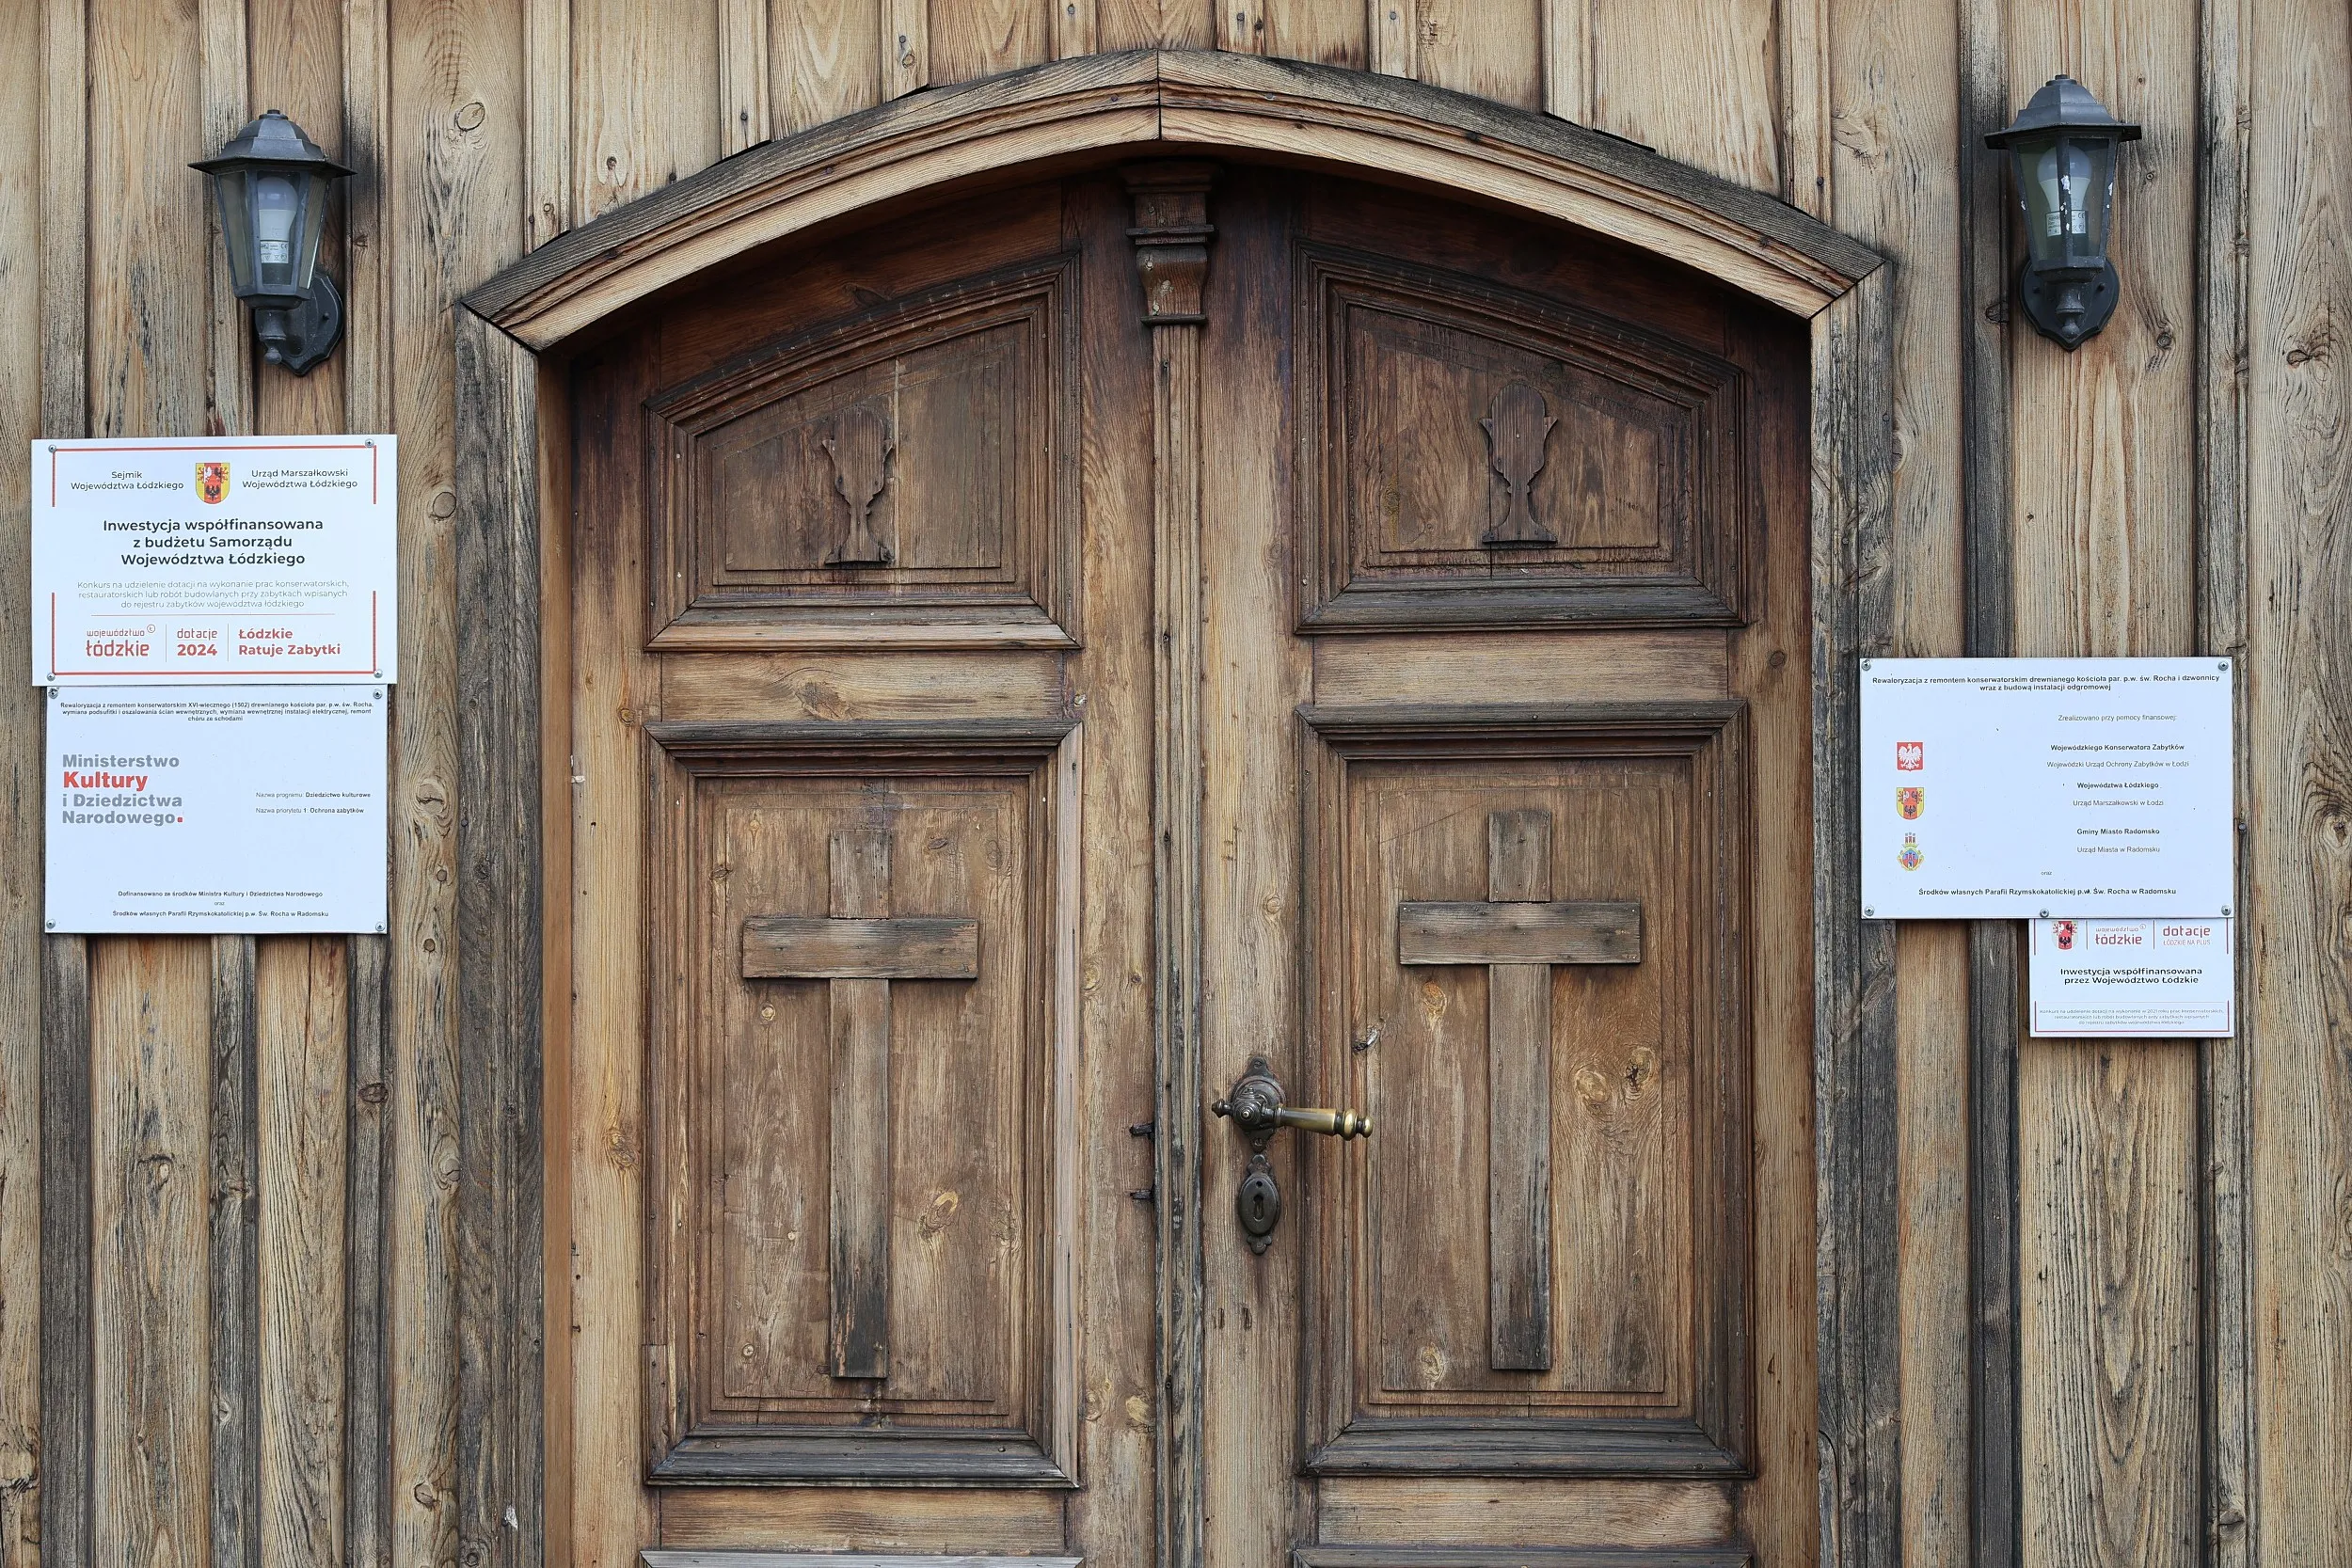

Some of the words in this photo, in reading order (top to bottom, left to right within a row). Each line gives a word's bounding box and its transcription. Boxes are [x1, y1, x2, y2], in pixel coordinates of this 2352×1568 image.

[112, 471, 142, 481] Sejmik
[251, 469, 278, 479] Urząd
[71, 482, 135, 491] Województwa
[136, 482, 183, 491] Łódzkiego
[242, 481, 307, 489] Województwa
[310, 480, 358, 489] Łódzkiego
[103, 519, 180, 533] Inwestycja
[184, 518, 323, 531] współfinansowana
[134, 539, 140, 548] z
[145, 536, 204, 547] budżetu
[210, 536, 292, 549] Samorządu
[121, 553, 224, 567] Województwa
[229, 552, 305, 567] Łódzkiego
[167, 581, 195, 590] dotacji
[209, 580, 253, 589] wykonanie
[184, 591, 239, 599] budowlanych
[261, 590, 302, 599] zabytkach
[304, 590, 348, 599] wpisanych
[167, 601, 205, 610] zabytków
[207, 600, 262, 609] województwa
[264, 599, 304, 609] łódzkiego
[87, 628, 145, 637] województwo
[177, 628, 217, 639] dotacje
[239, 628, 293, 639] Łódzkie
[87, 640, 150, 657] łódzkie
[177, 644, 217, 657] 2024
[239, 644, 283, 657] Ratuje
[288, 644, 341, 657] Zabytki
[63, 754, 180, 768] Ministerstwo
[64, 771, 148, 792] Kultury
[63, 794, 67, 807] i
[73, 794, 182, 807] Dziedzictwa
[2009, 888, 2075, 896] Rzymskokatolickiej
[2163, 926, 2210, 937] dotacje
[2095, 934, 2142, 945] łódzkie
[2060, 968, 2110, 976] Inwestycja
[2092, 976, 2159, 985] Województwo
